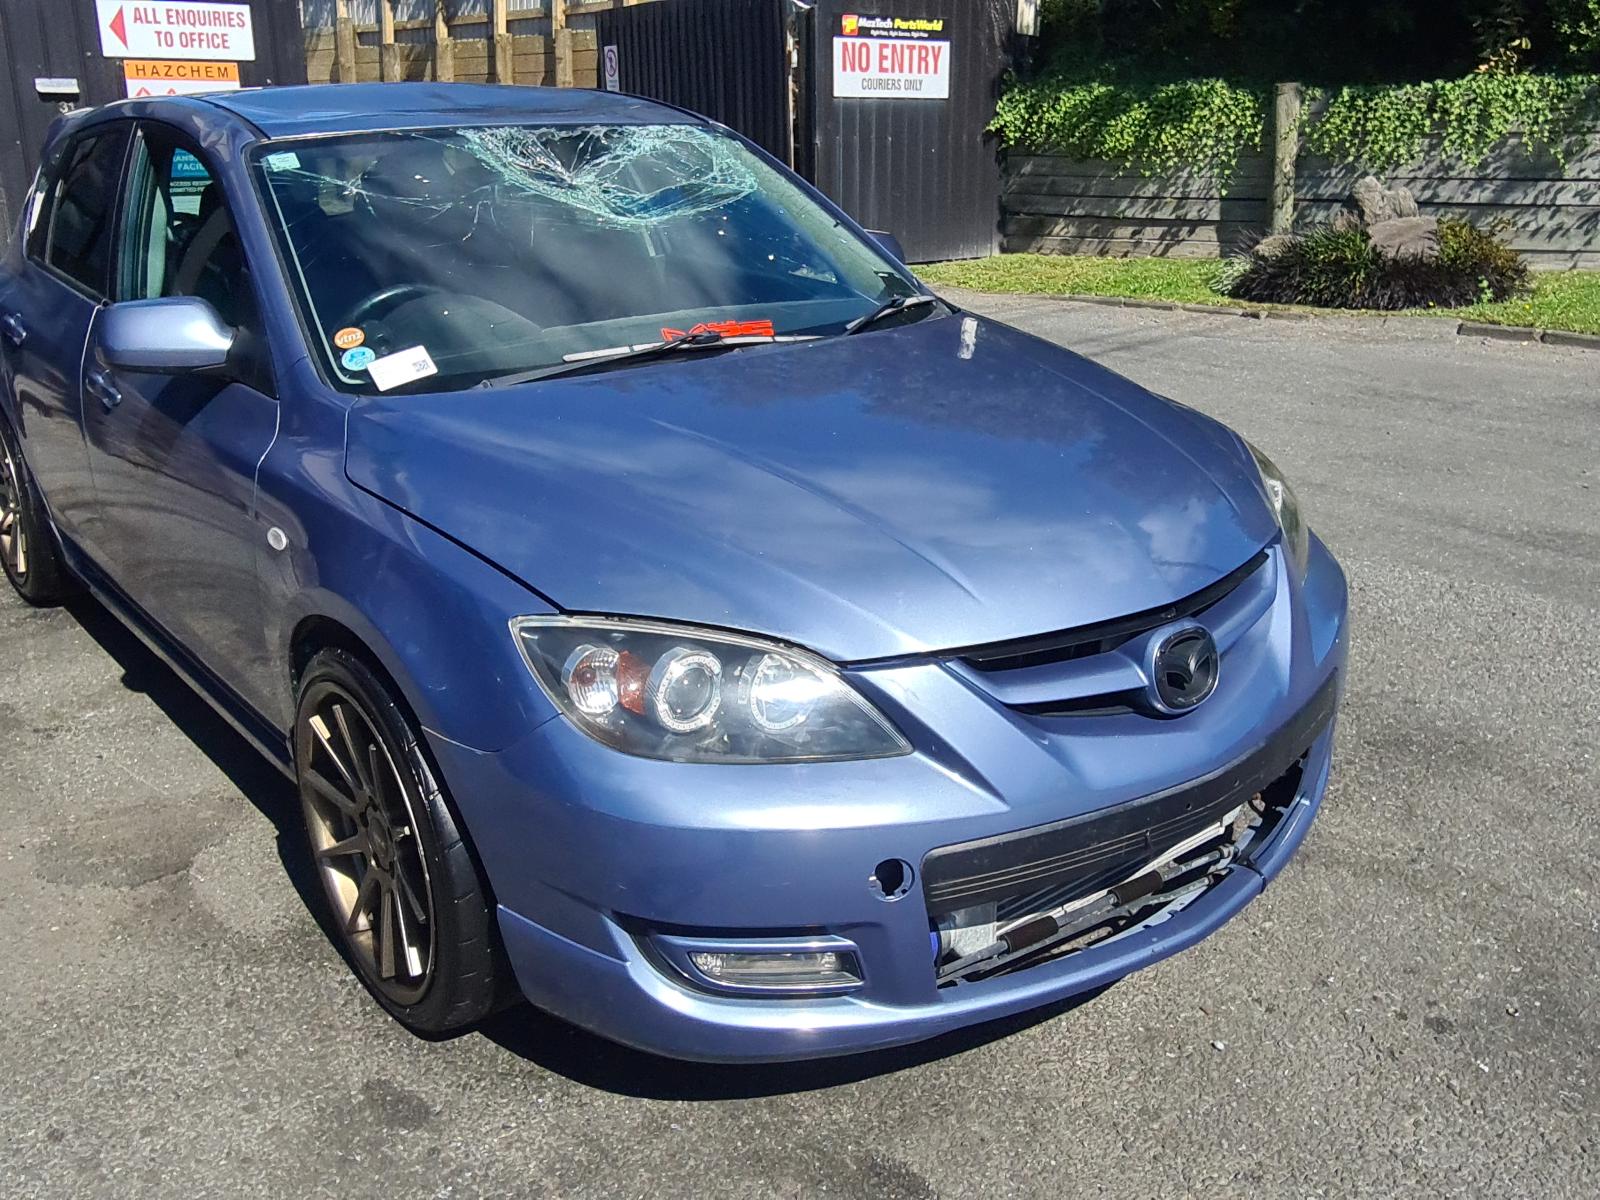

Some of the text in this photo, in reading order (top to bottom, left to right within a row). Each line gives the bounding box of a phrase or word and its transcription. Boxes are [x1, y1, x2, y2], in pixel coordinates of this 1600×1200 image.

[133, 7, 246, 28] ALL ENQUIRIES
[154, 30, 230, 49] TO OFFICE
[842, 41, 942, 75] NO ENTRY
[135, 64, 229, 78] HAZCHEM
[861, 78, 923, 91] COURIERS ONLY
